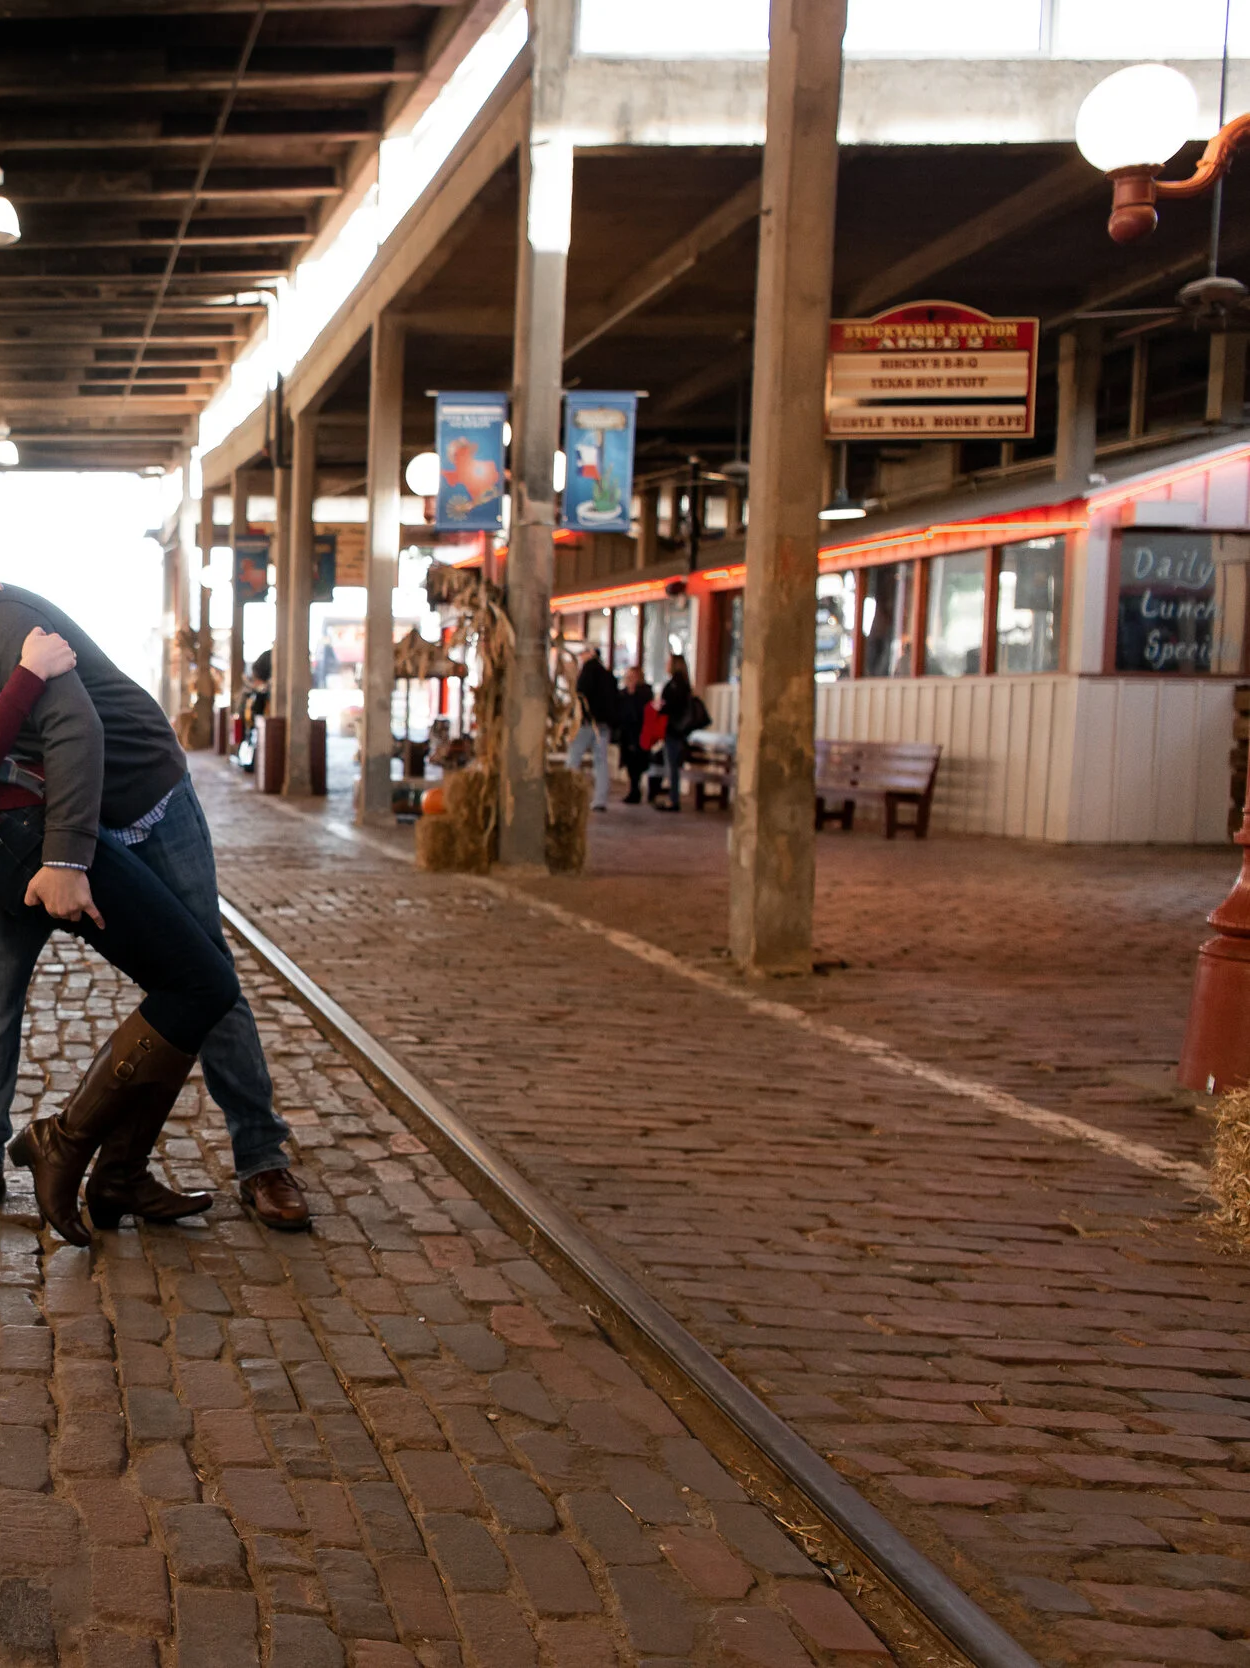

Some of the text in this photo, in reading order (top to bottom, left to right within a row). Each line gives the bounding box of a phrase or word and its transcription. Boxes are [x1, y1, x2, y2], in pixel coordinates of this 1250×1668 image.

[844, 323, 1019, 338] STOCKYARDS STATION
[878, 336, 961, 349] AISLE
[871, 376, 988, 389] TEXAS HOT STUFF
[891, 415, 927, 428] TOLL
[933, 415, 982, 428] HOUSE
[1134, 547, 1215, 589] Daily
[1141, 588, 1220, 618] Lunch
[1144, 628, 1215, 670] Speci
